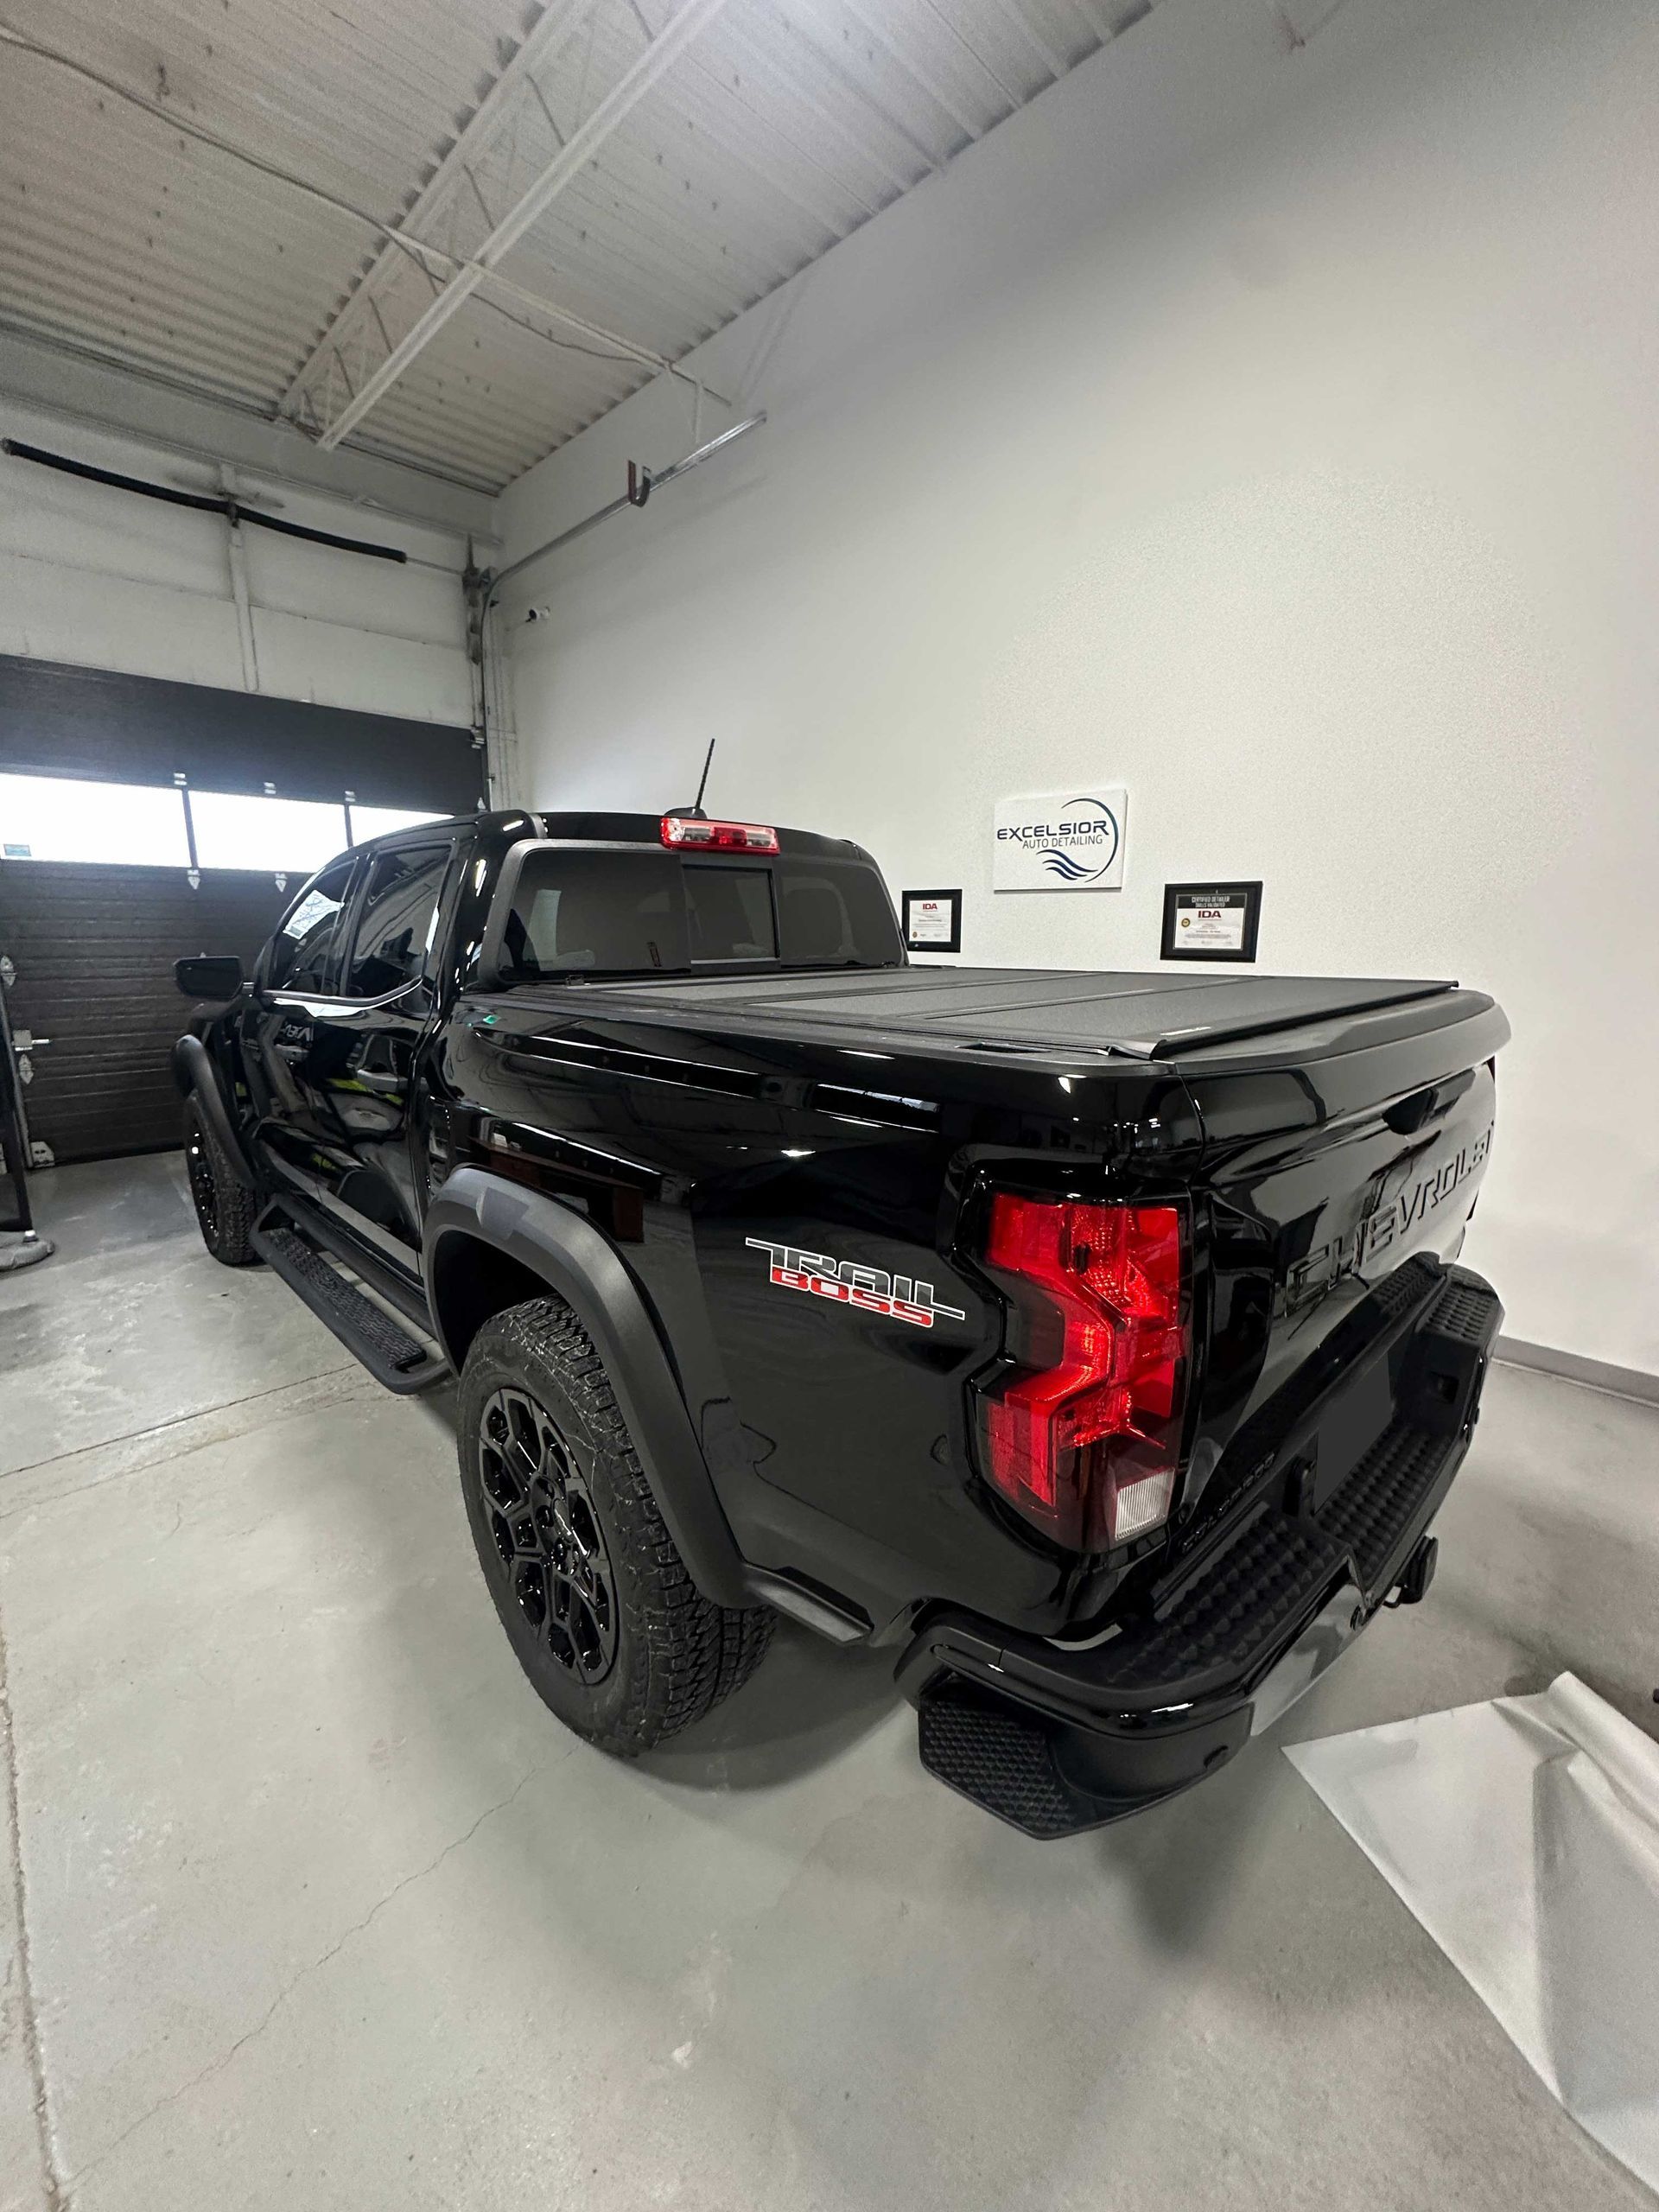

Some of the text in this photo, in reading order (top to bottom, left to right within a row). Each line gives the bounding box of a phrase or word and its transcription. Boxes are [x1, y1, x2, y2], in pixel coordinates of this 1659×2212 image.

[997, 820, 1109, 842] EXCELSIOR
[1022, 834, 1103, 849] AUTO DETAILING
[1198, 910, 1222, 918] IDA
[745, 1236, 966, 1321] TRAIL
[770, 1265, 935, 1328] BOSS
